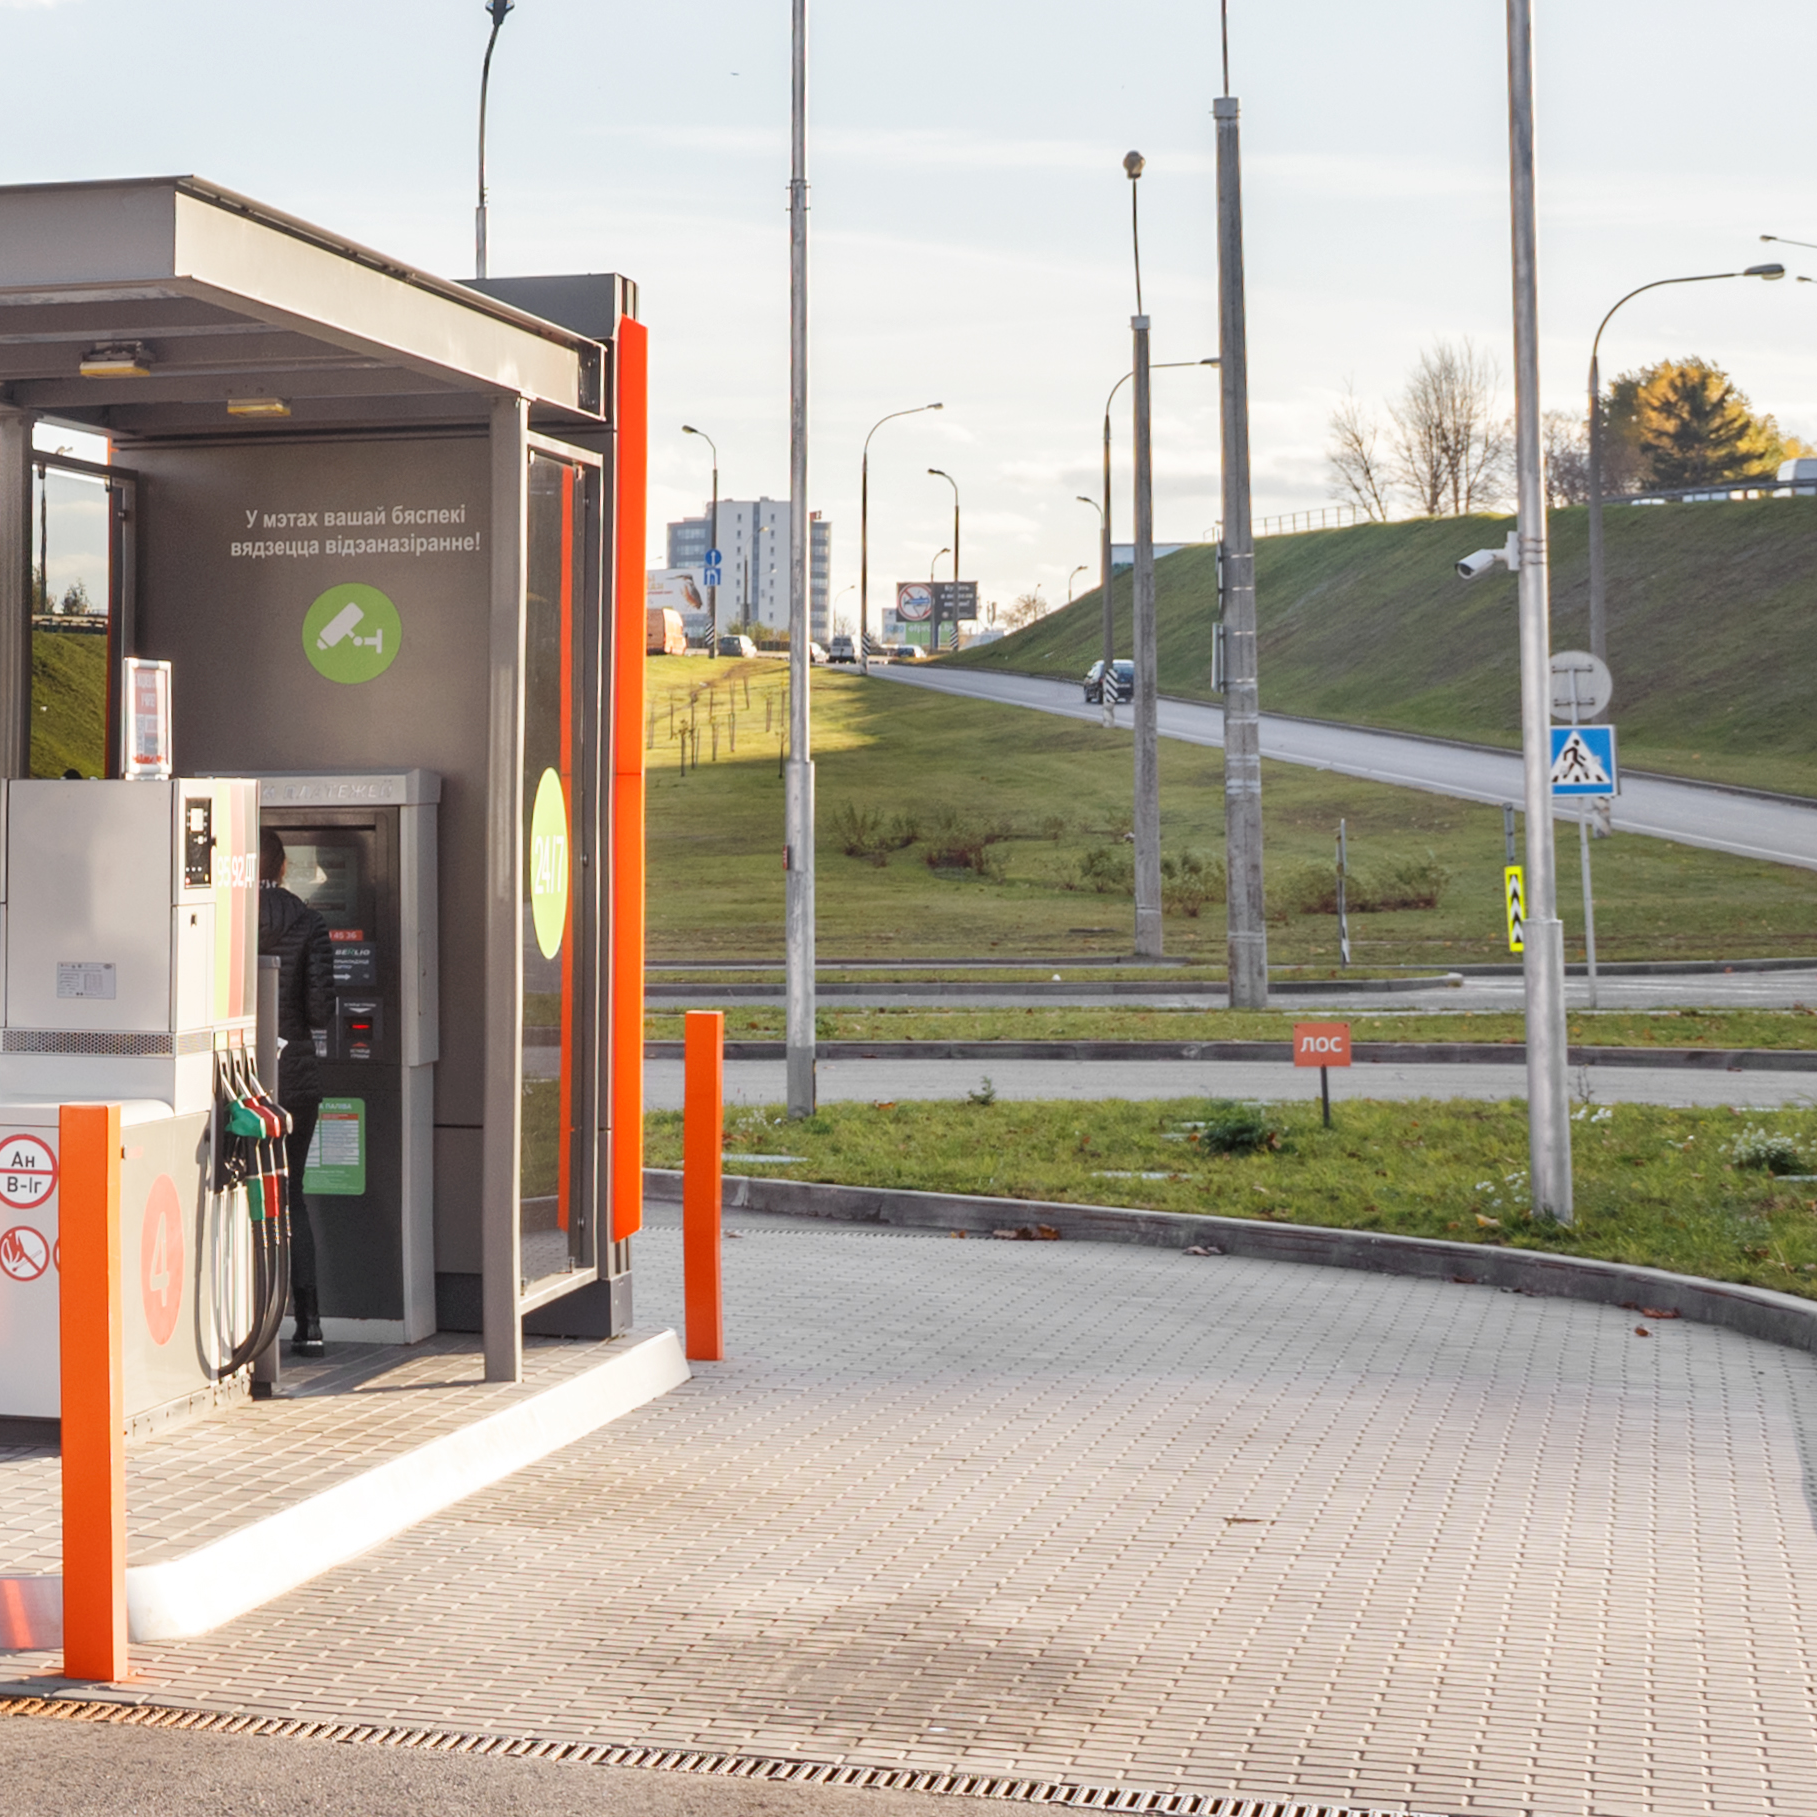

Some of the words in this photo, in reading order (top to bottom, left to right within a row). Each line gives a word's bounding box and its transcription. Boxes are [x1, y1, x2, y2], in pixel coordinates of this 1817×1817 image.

[245, 509, 258, 529] У
[263, 511, 319, 528] мэтах
[324, 506, 386, 527] вашай
[392, 504, 466, 525] бяспекі
[230, 539, 320, 559] вядзецца
[325, 532, 481, 557] відэаназіранне!
[283, 780, 393, 799] ПЛАТЕЖЕЙ
[217, 855, 231, 887] 95
[231, 855, 244, 887] 92
[244, 853, 256, 888] ДТ
[535, 835, 564, 894] 24/7
[335, 948, 371, 956] BERLIO
[1300, 1036, 1342, 1053] ЛОС
[11, 1151, 35, 1168] Ан
[149, 1211, 170, 1308] 4
